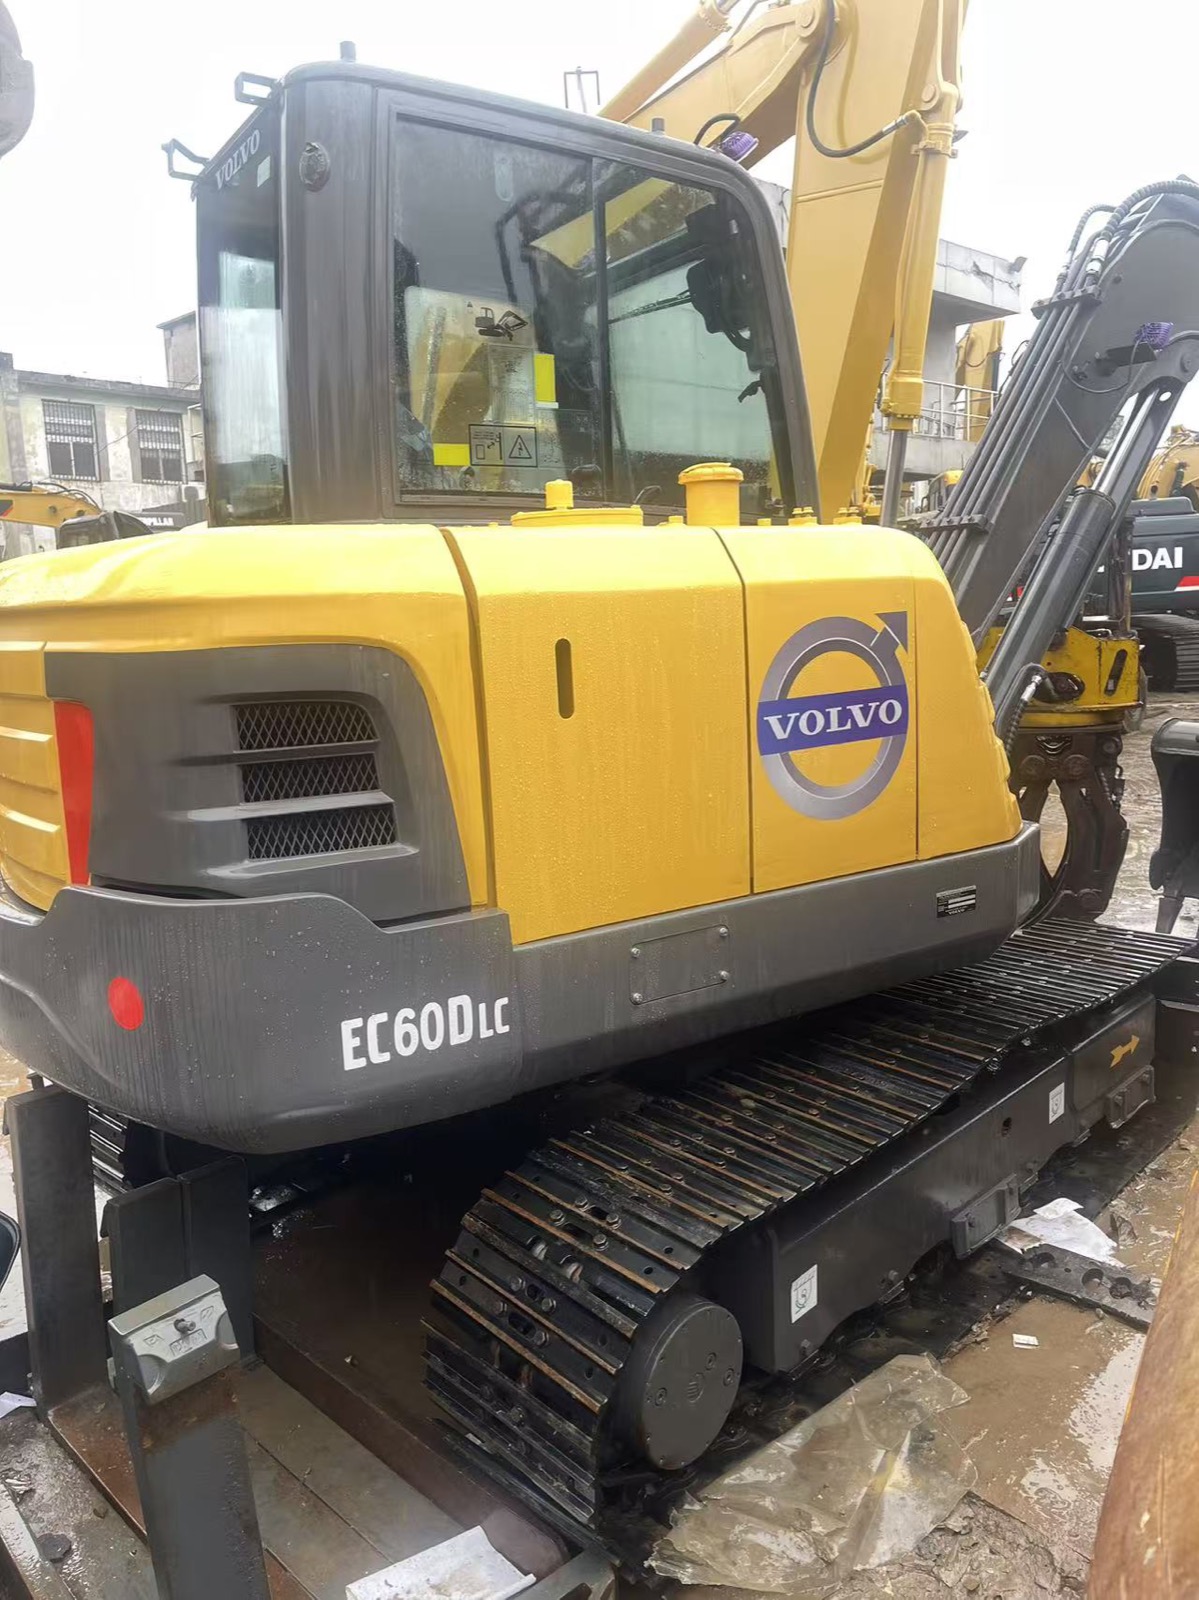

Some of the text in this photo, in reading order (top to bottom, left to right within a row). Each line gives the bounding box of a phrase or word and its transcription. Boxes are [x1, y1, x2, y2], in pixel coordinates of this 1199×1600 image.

[215, 129, 260, 190] VOLVO
[1128, 546, 1184, 571] DAI
[763, 699, 903, 740] VOLVO
